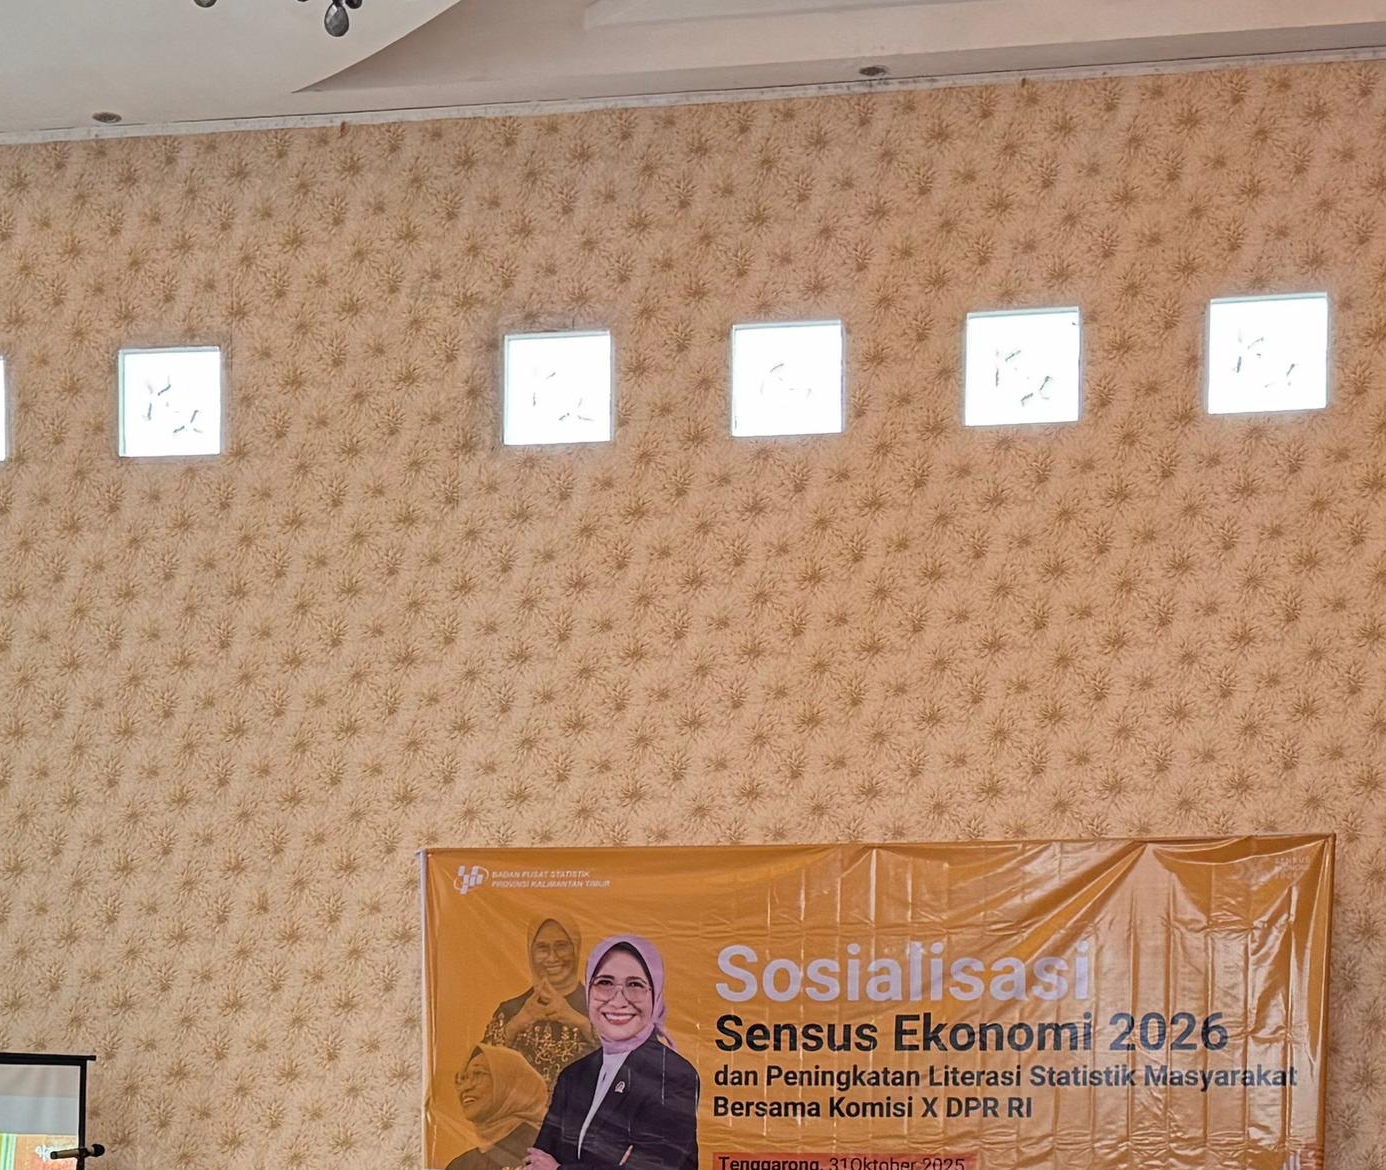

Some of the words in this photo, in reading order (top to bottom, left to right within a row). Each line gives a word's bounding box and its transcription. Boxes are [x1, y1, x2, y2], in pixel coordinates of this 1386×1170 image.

[522, 871, 549, 879] PUSAT
[715, 941, 1091, 1002] Sosialisasi
[714, 1014, 879, 1052] Sensus
[894, 1012, 1093, 1052] Ekonomi
[1108, 1012, 1229, 1052] 2026
[714, 1064, 758, 1087] dan
[766, 1064, 920, 1092] Peningkatan
[928, 1064, 1022, 1087] Literasi
[1029, 1064, 1137, 1087] Statistik
[1144, 1064, 1298, 1092] Masyarakat
[713, 1096, 821, 1118] Bersama
[828, 1096, 913, 1118] Komisi
[921, 1097, 939, 1118] X
[946, 1097, 999, 1118] DPR
[1007, 1097, 1033, 1118] RI
